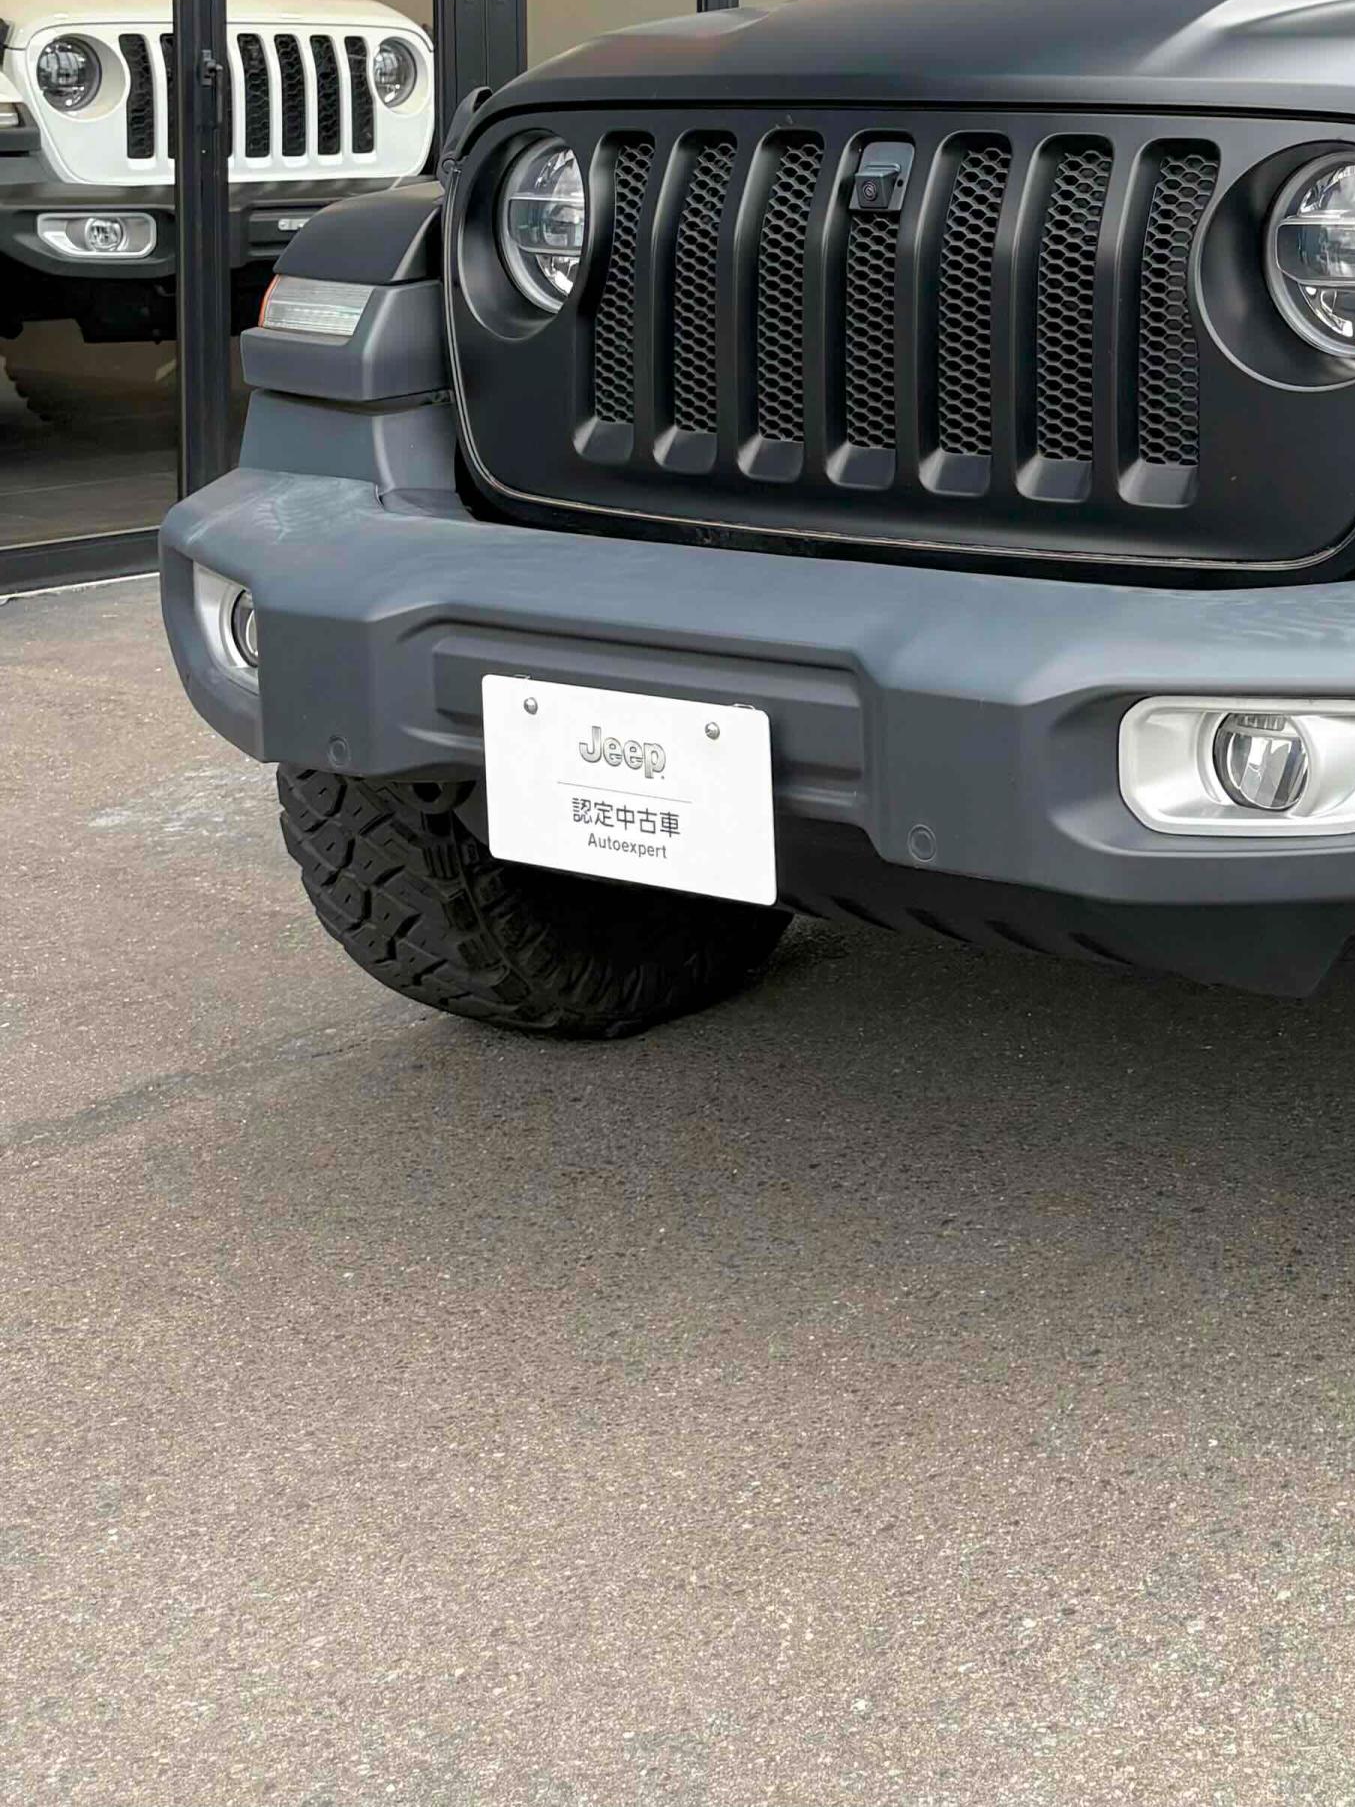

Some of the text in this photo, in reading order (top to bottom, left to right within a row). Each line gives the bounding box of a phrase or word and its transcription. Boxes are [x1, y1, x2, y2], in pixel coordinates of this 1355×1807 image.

[578, 725, 667, 779] Jeep
[572, 797, 681, 838] 認定中古車
[588, 833, 668, 859] Autoexpert
